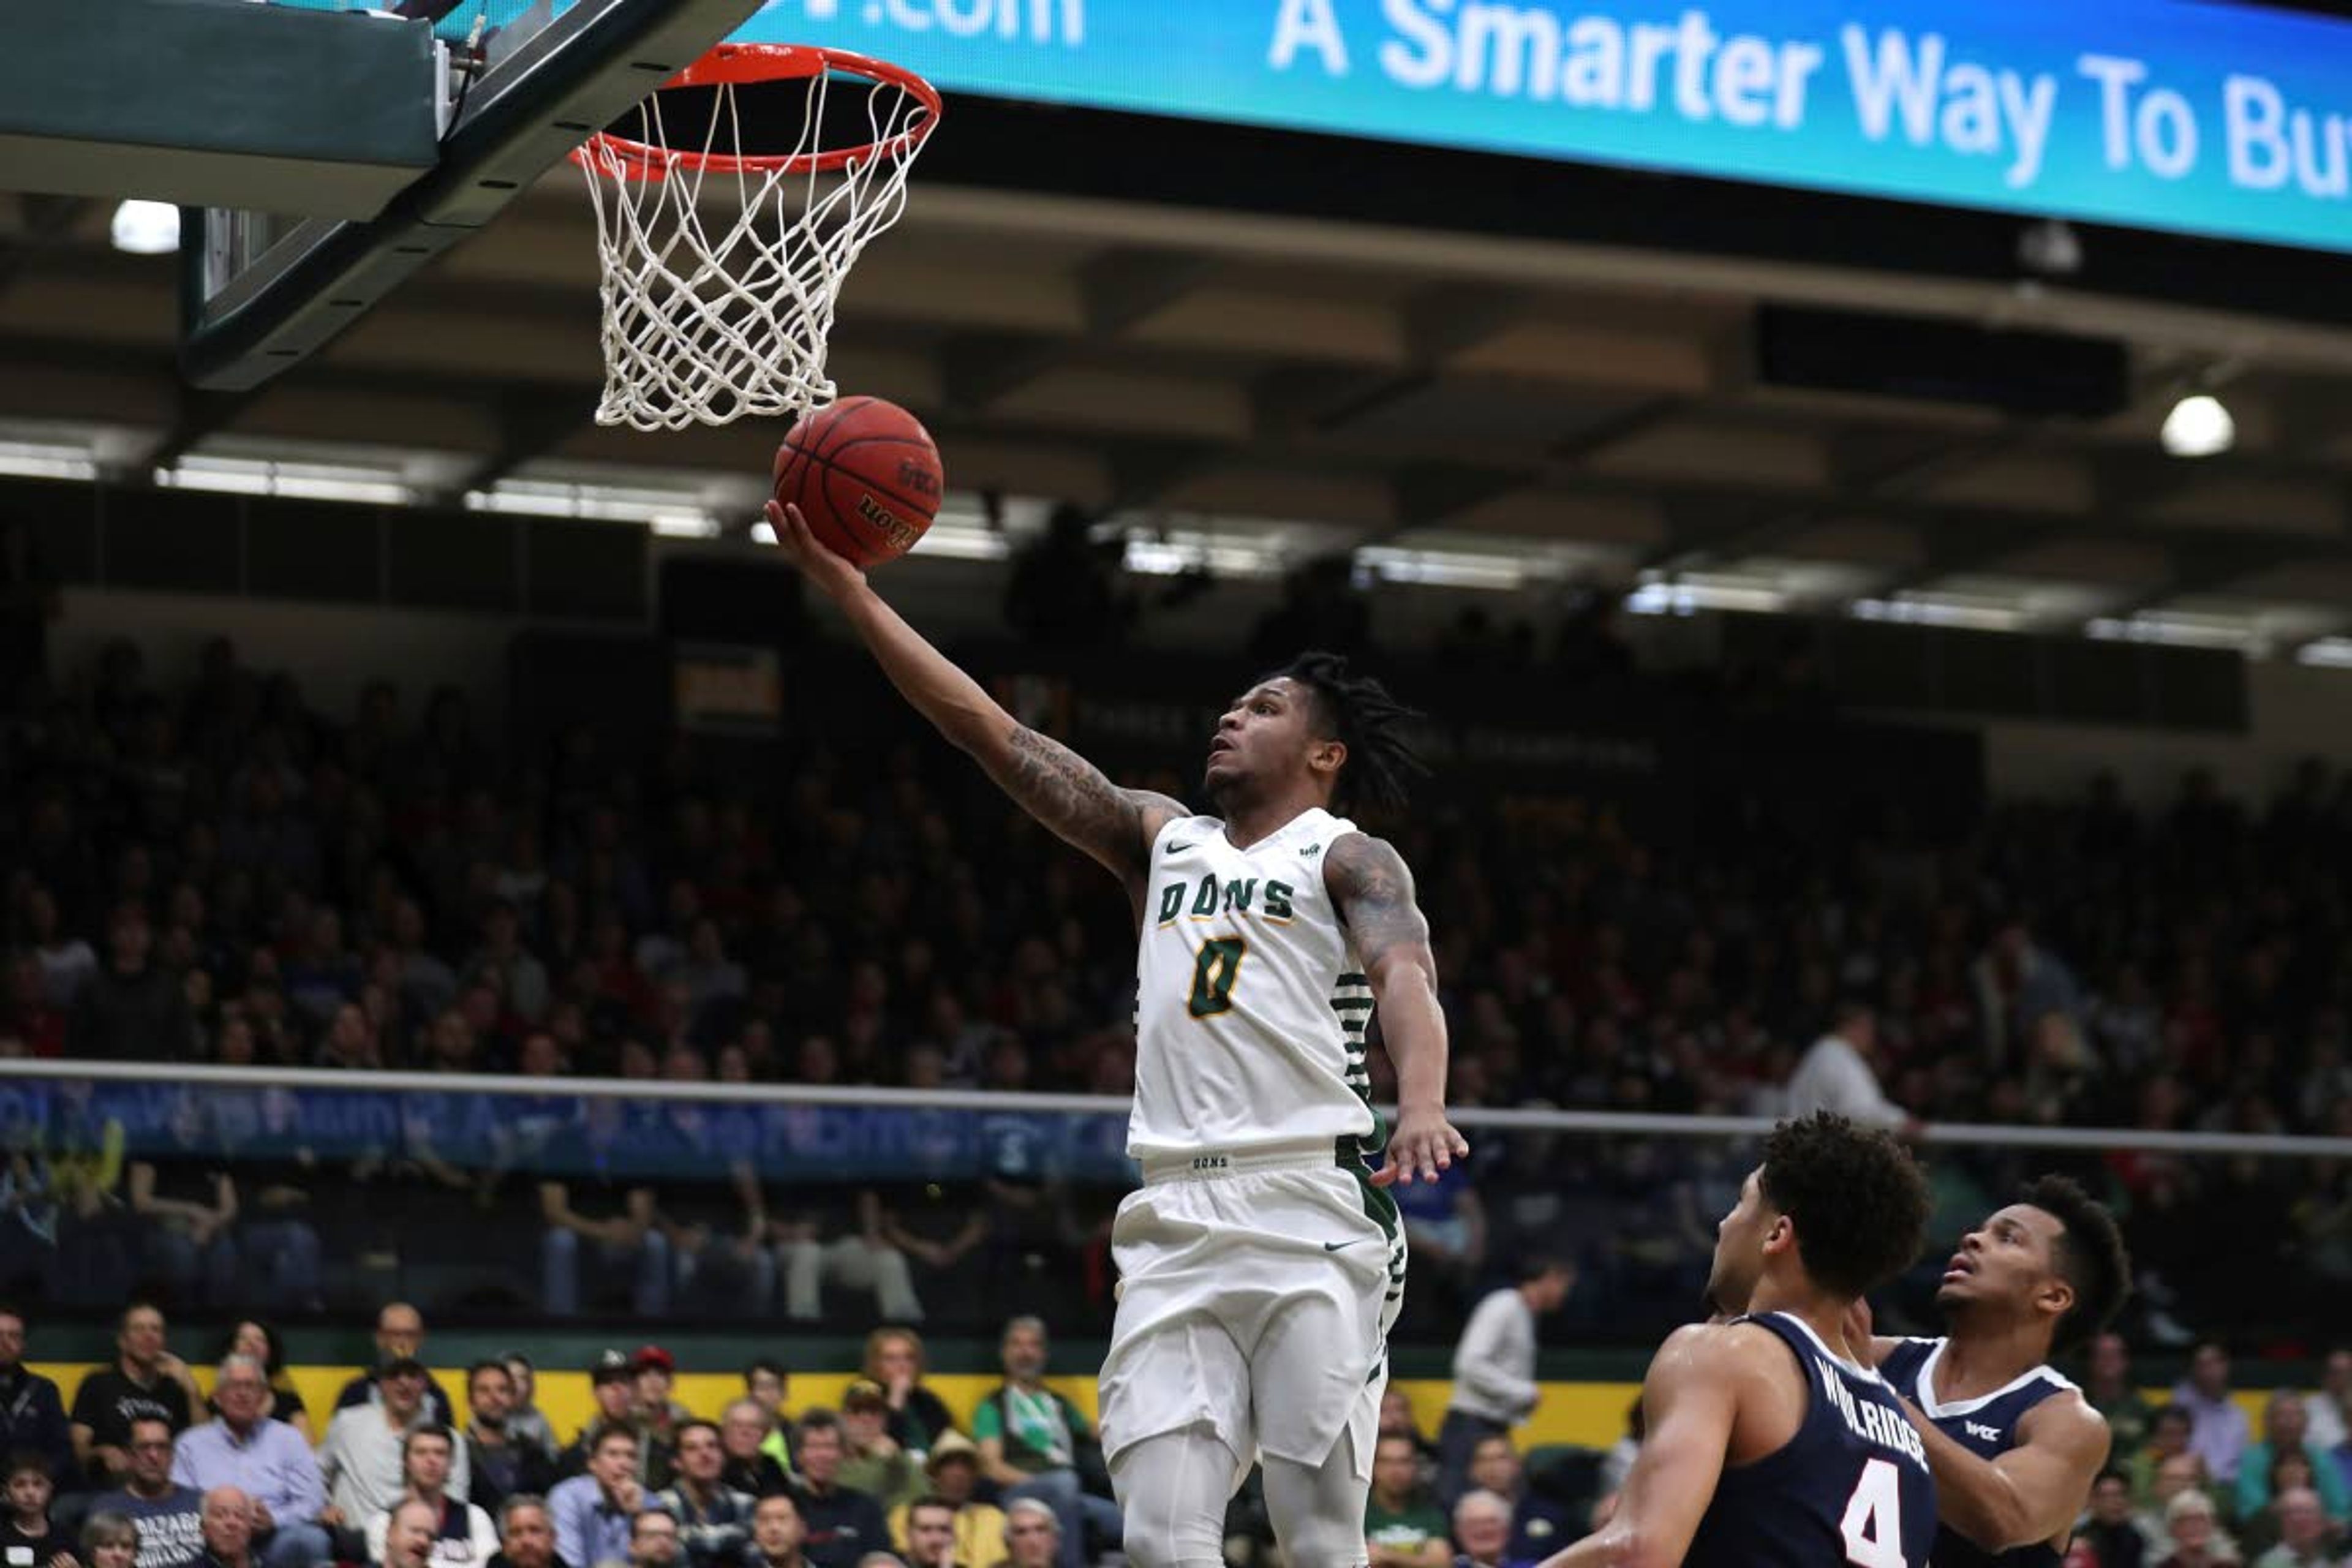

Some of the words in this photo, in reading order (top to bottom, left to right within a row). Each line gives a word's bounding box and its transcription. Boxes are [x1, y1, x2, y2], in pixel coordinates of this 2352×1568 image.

[1268, 0, 1348, 74] A
[1379, 0, 1822, 130] Smarter
[1842, 22, 2057, 189] Way
[2076, 53, 2200, 179] To
[2223, 72, 2352, 198] Bu
[1158, 873, 1295, 927] DONS
[1187, 933, 1248, 1020] 0
[1839, 1457, 1909, 1568] 4
